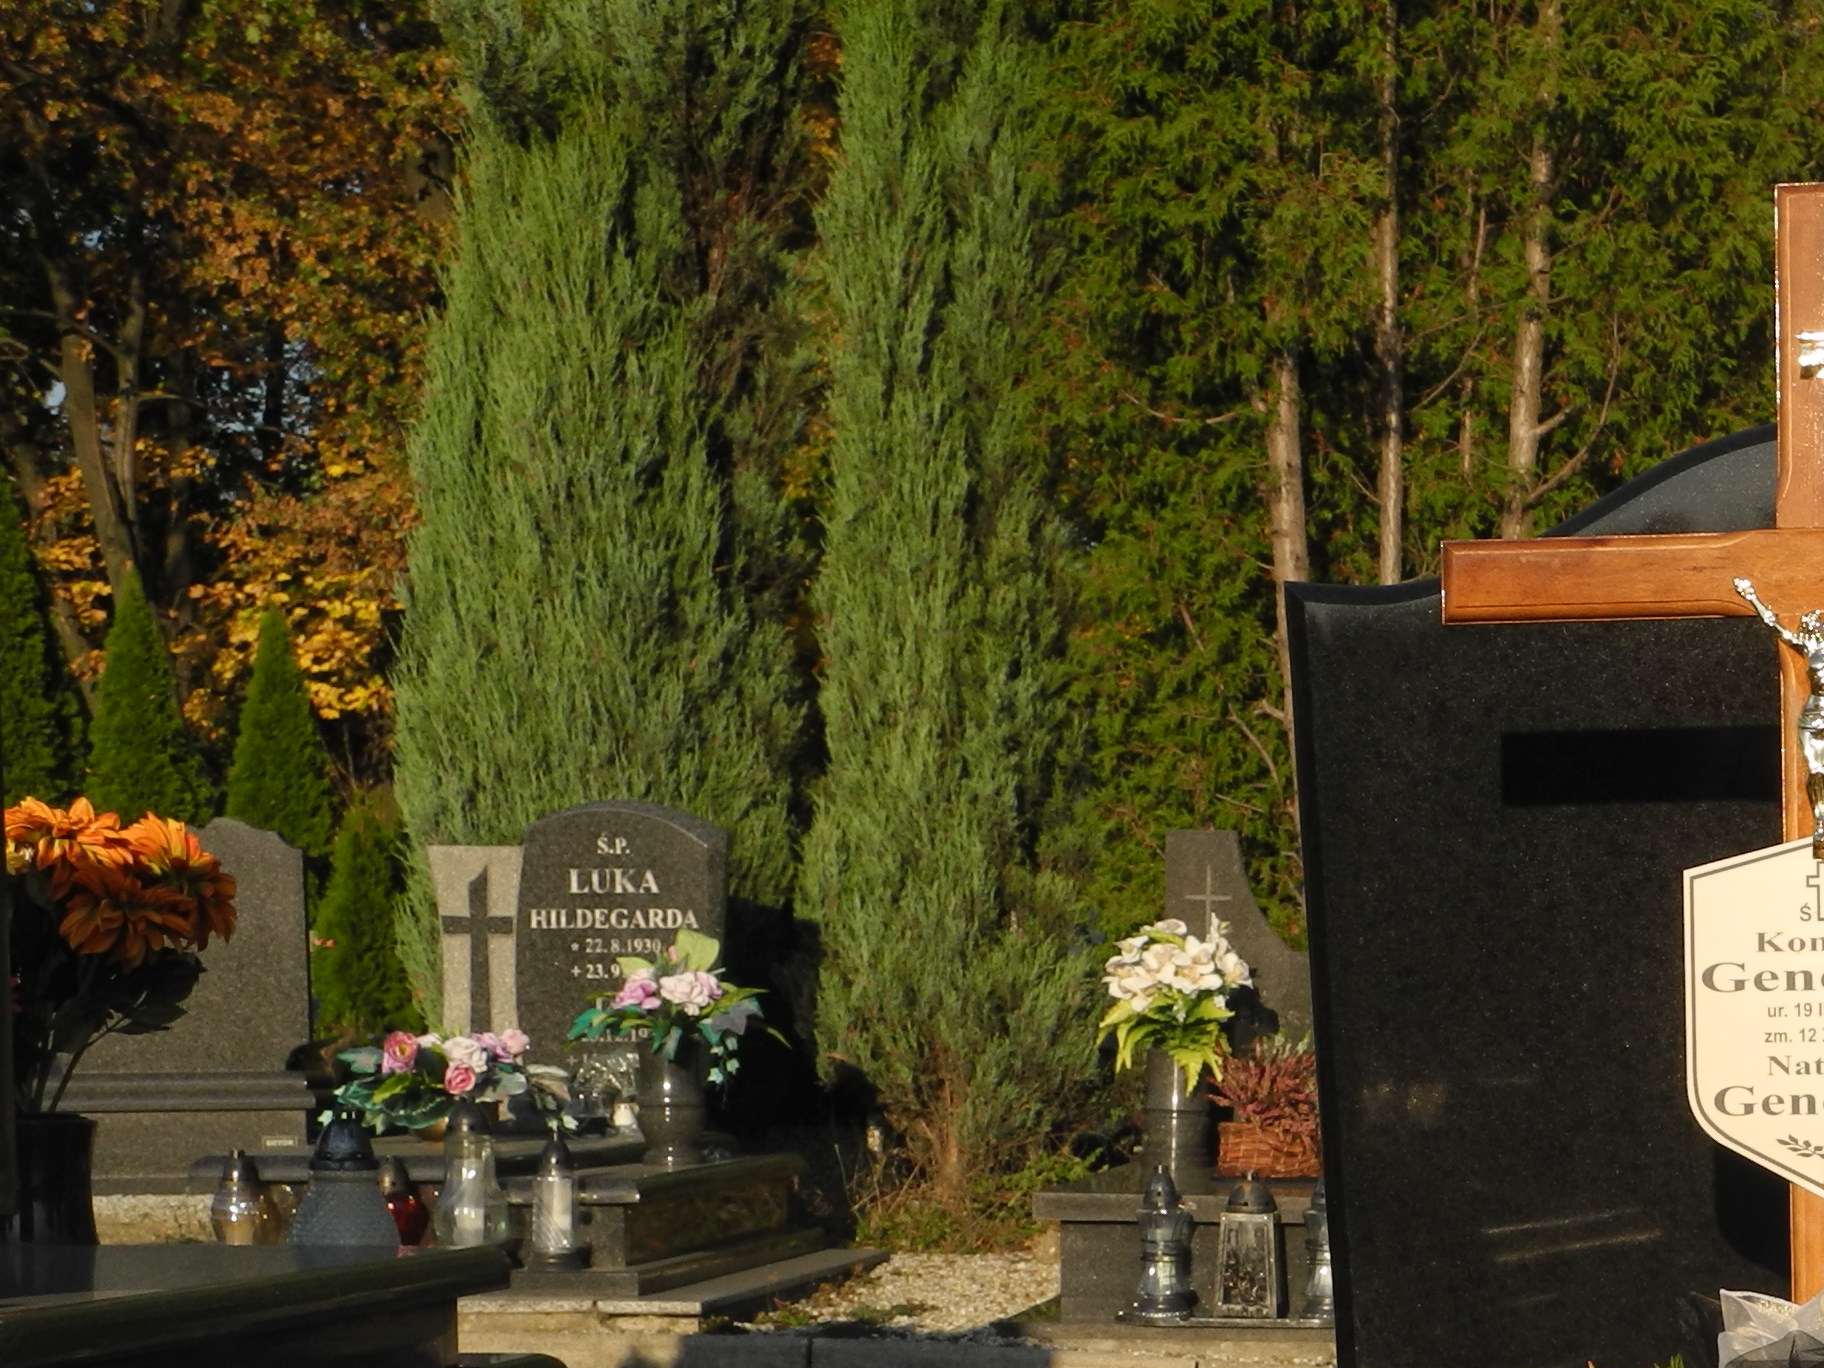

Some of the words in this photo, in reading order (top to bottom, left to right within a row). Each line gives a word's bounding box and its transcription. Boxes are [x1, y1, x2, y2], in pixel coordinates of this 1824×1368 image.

[569, 868, 660, 894] LUKA
[529, 908, 699, 930] HILDEGARDA
[1800, 902, 1811, 922] Ś
[1767, 1004, 1788, 1018] ur.
[1794, 1003, 1812, 1017] 19
[1764, 1030, 1793, 1044] zm.
[1799, 1028, 1816, 1043] 12
